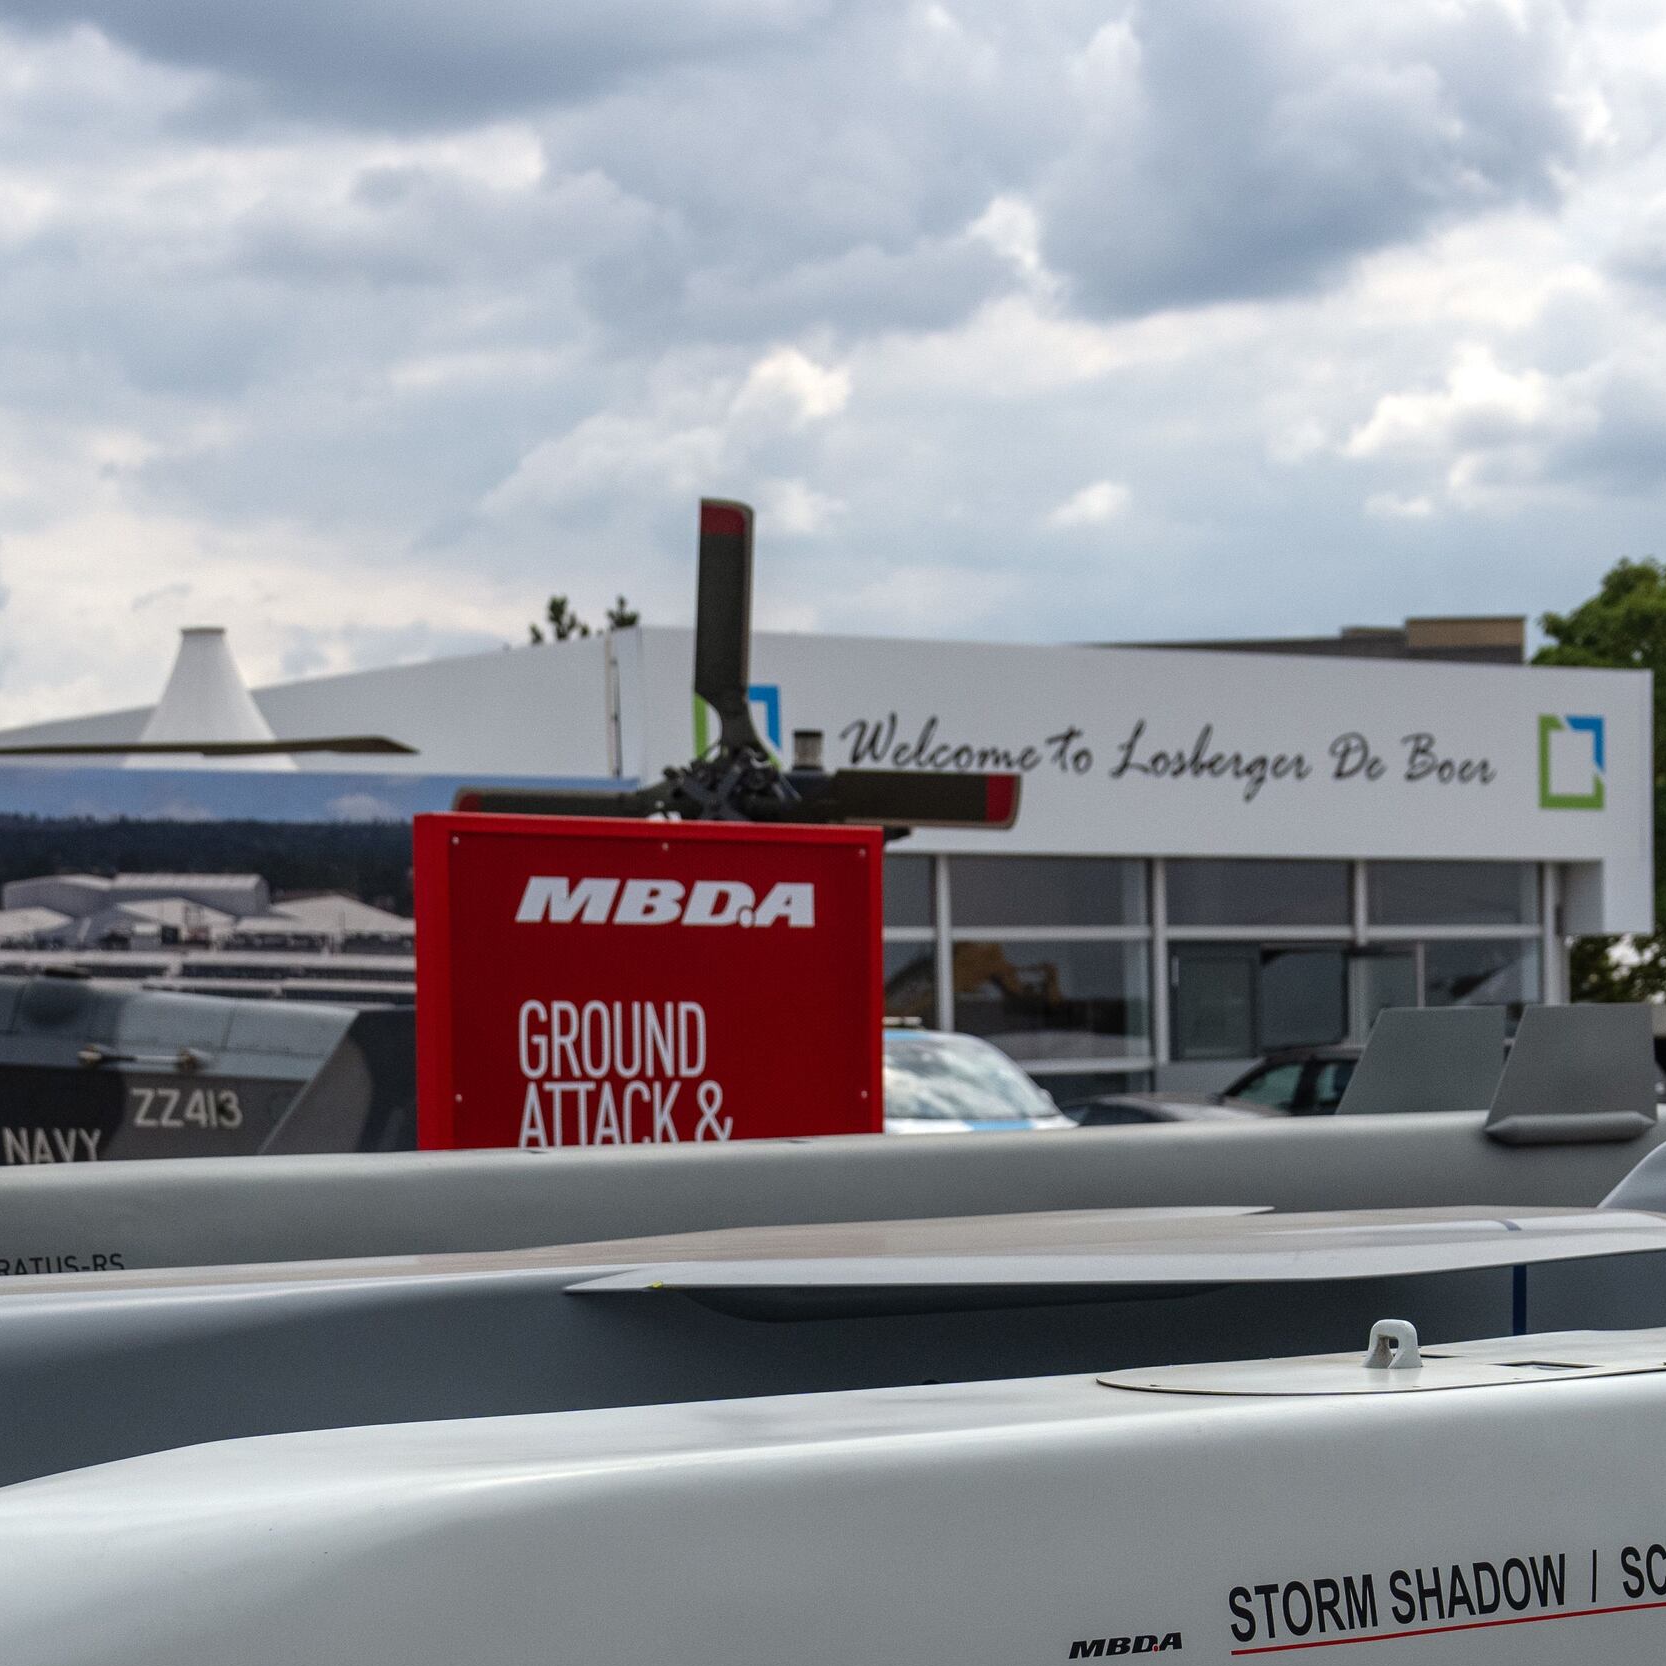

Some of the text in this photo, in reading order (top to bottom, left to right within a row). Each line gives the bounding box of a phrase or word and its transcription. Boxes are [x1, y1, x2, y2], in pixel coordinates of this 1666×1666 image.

[839, 711, 1042, 771] Welcome
[1109, 717, 1313, 802] Losberger
[1328, 731, 1387, 782] De
[1400, 731, 1497, 786] Boer
[514, 876, 815, 928] MBDA
[518, 998, 708, 1079] GROUND
[131, 1086, 243, 1128] ZZ413
[519, 1079, 734, 1149] ATTACK &
[1, 1126, 102, 1165] NAVY
[1228, 1573, 1379, 1643] STORM
[1388, 1553, 1566, 1625] SHADOW
[1068, 1632, 1183, 1660] MBDA
